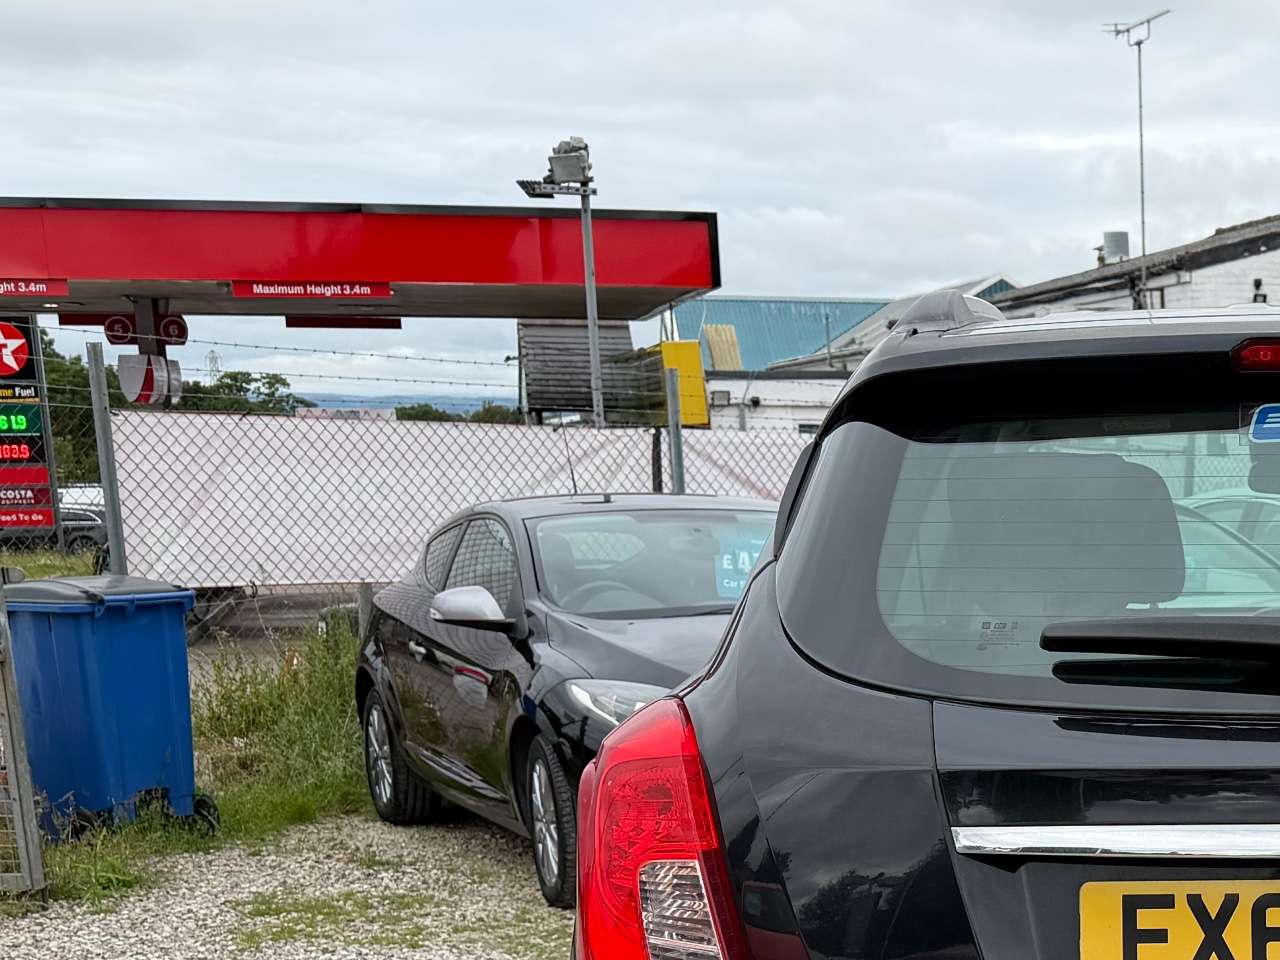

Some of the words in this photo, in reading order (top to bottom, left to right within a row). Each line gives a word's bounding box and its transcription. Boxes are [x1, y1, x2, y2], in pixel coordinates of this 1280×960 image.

[18, 282, 47, 293] 3.4m
[253, 284, 304, 294] Maximum
[306, 284, 341, 297] Height
[343, 284, 371, 294] 3.4m
[169, 324, 179, 334] 6
[15, 387, 36, 397] Fuel
[0, 490, 34, 499] COSTA
